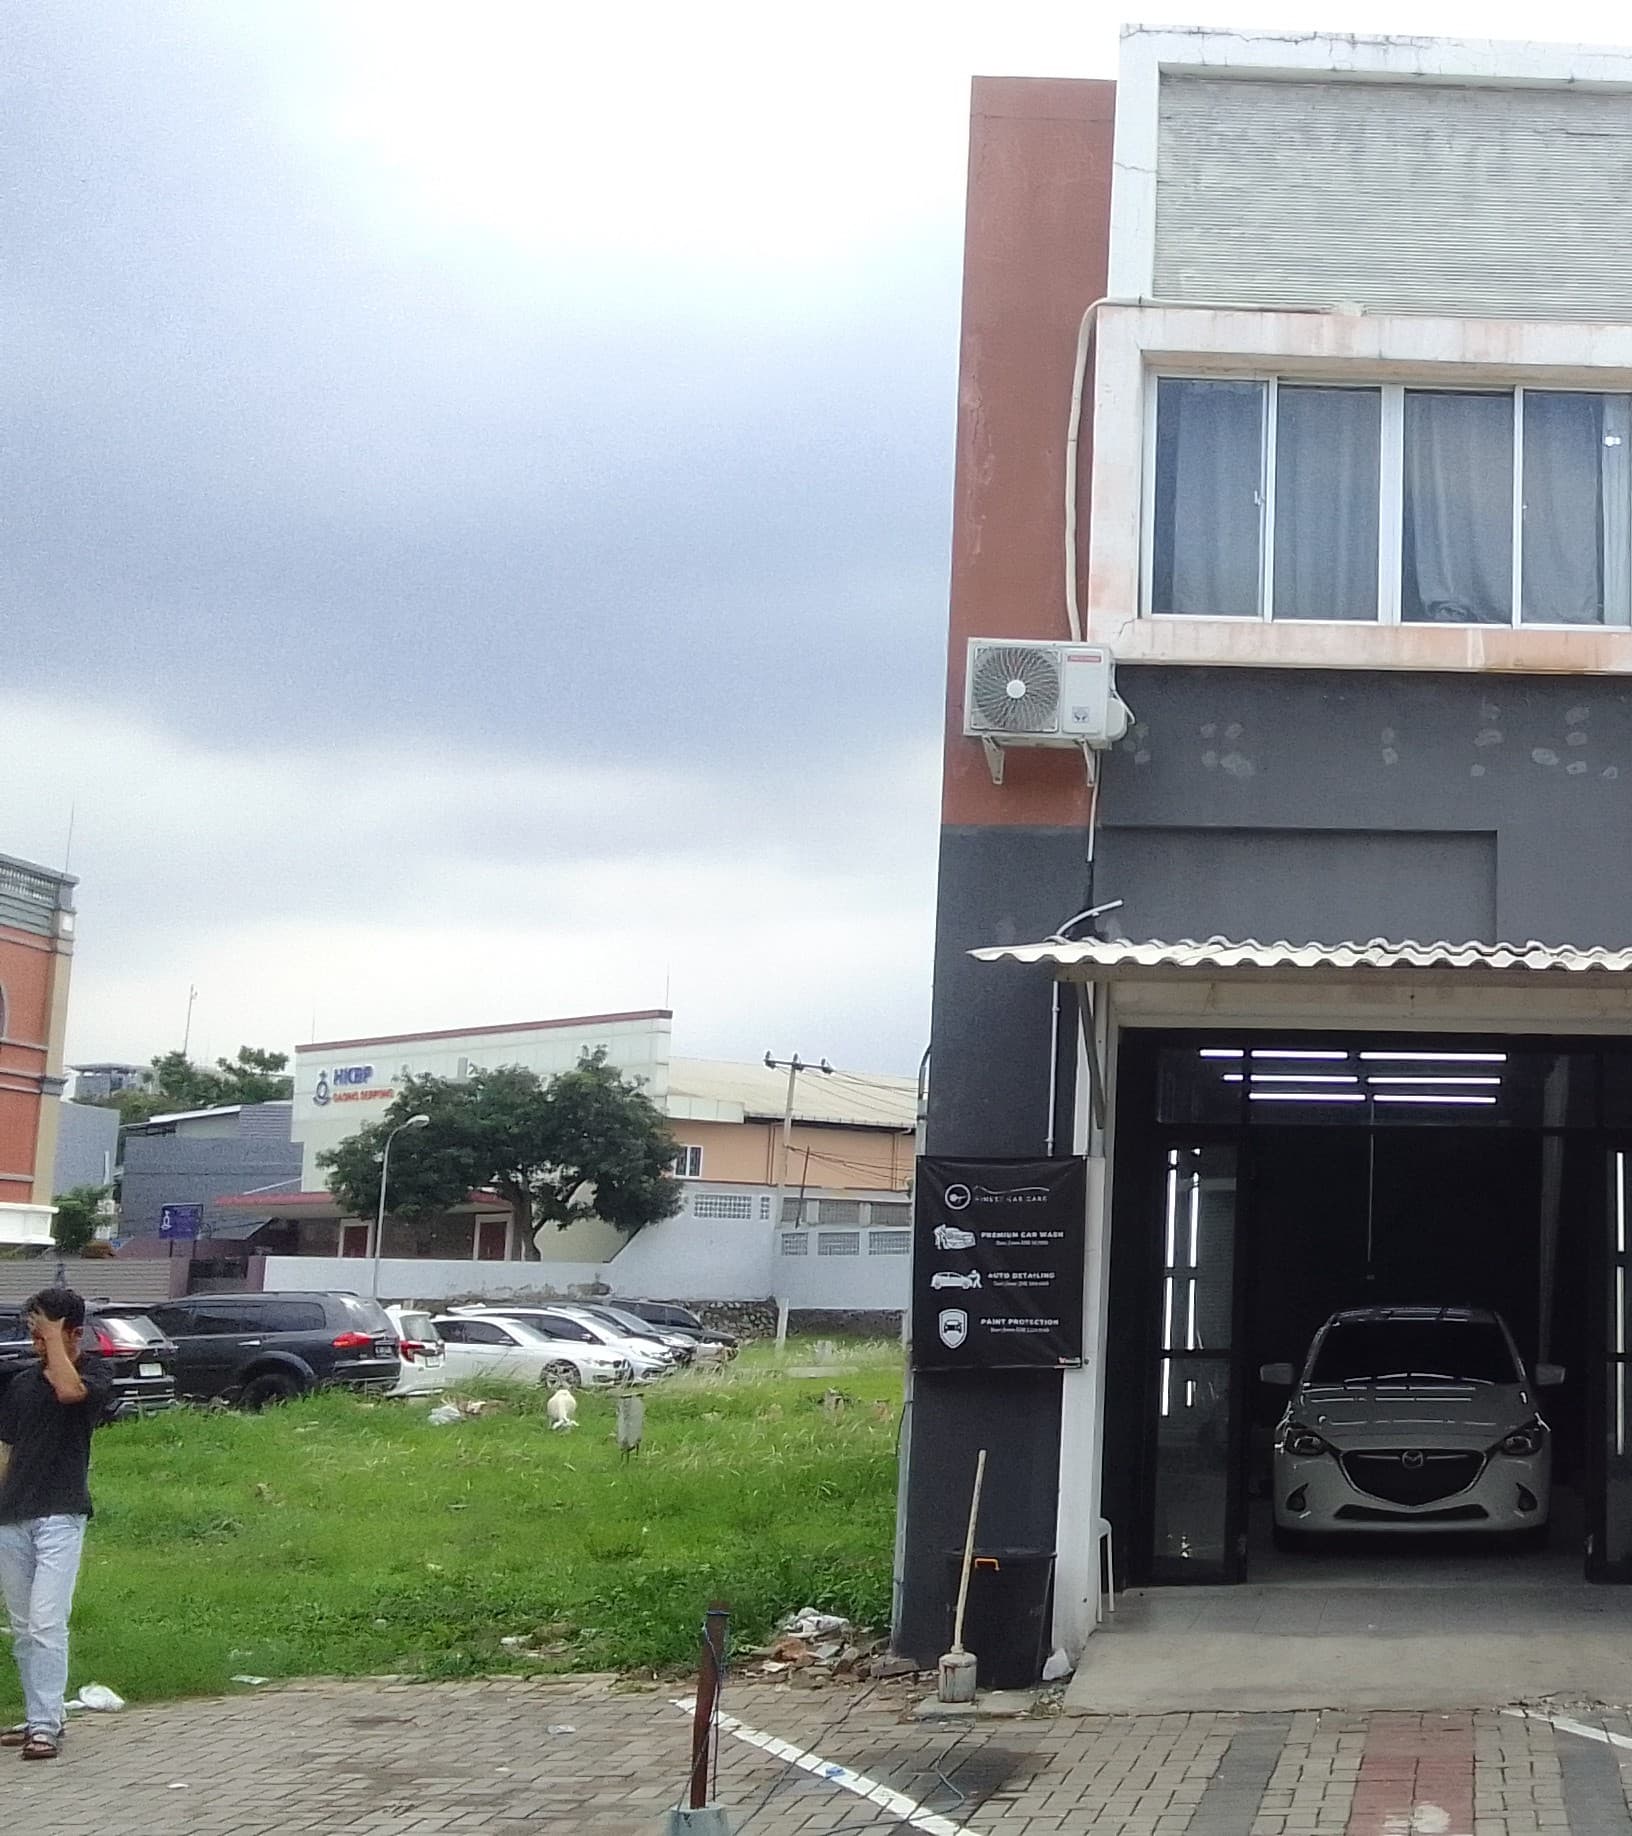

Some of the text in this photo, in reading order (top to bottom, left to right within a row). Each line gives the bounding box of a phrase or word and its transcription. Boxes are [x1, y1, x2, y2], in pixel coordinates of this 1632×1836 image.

[333, 1065, 373, 1086] HKBP
[980, 1318, 1059, 1326] PAINT PROTECTION
